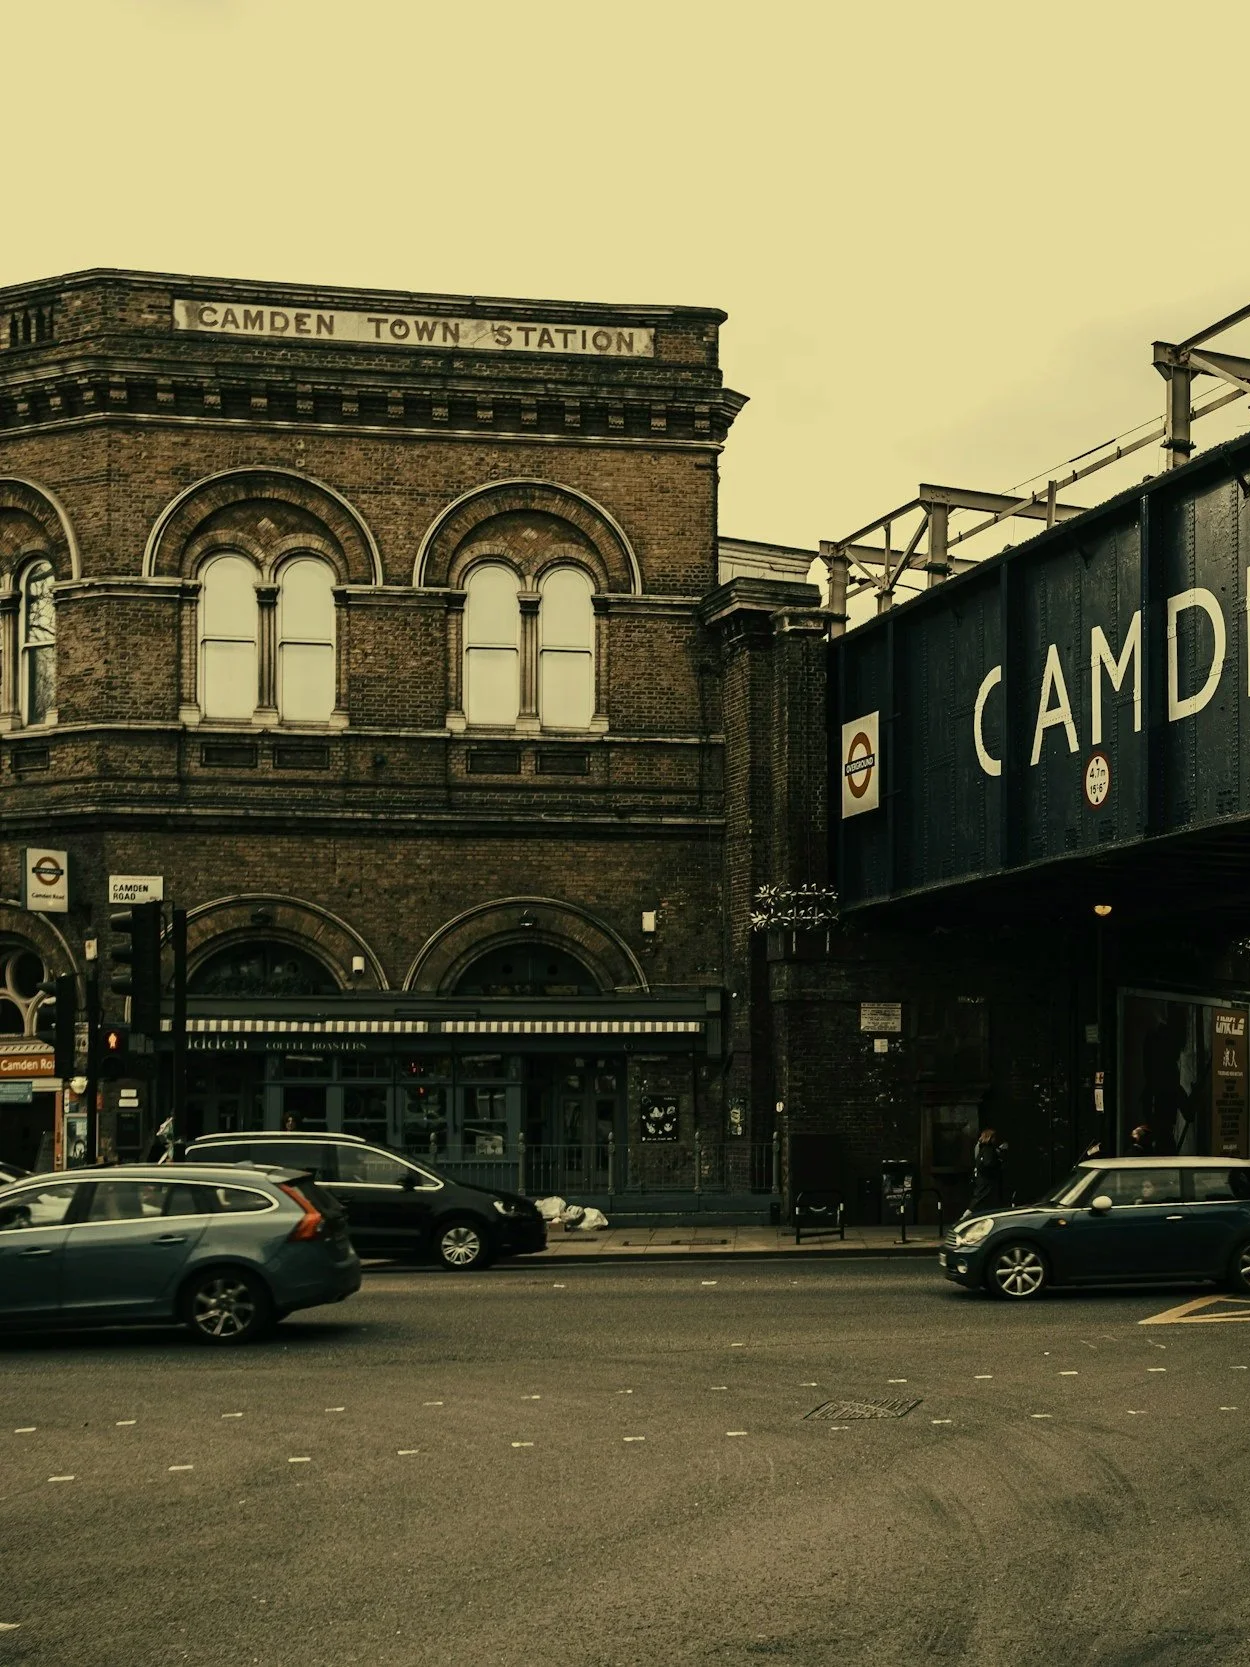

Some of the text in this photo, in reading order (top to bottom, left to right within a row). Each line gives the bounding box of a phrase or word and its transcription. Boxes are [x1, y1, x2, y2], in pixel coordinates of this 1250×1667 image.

[199, 306, 634, 352] CAMDEN TOWN STATION
[113, 884, 149, 893] CAMDEN
[113, 893, 136, 901] ROAD
[1, 1058, 39, 1071] Camden
